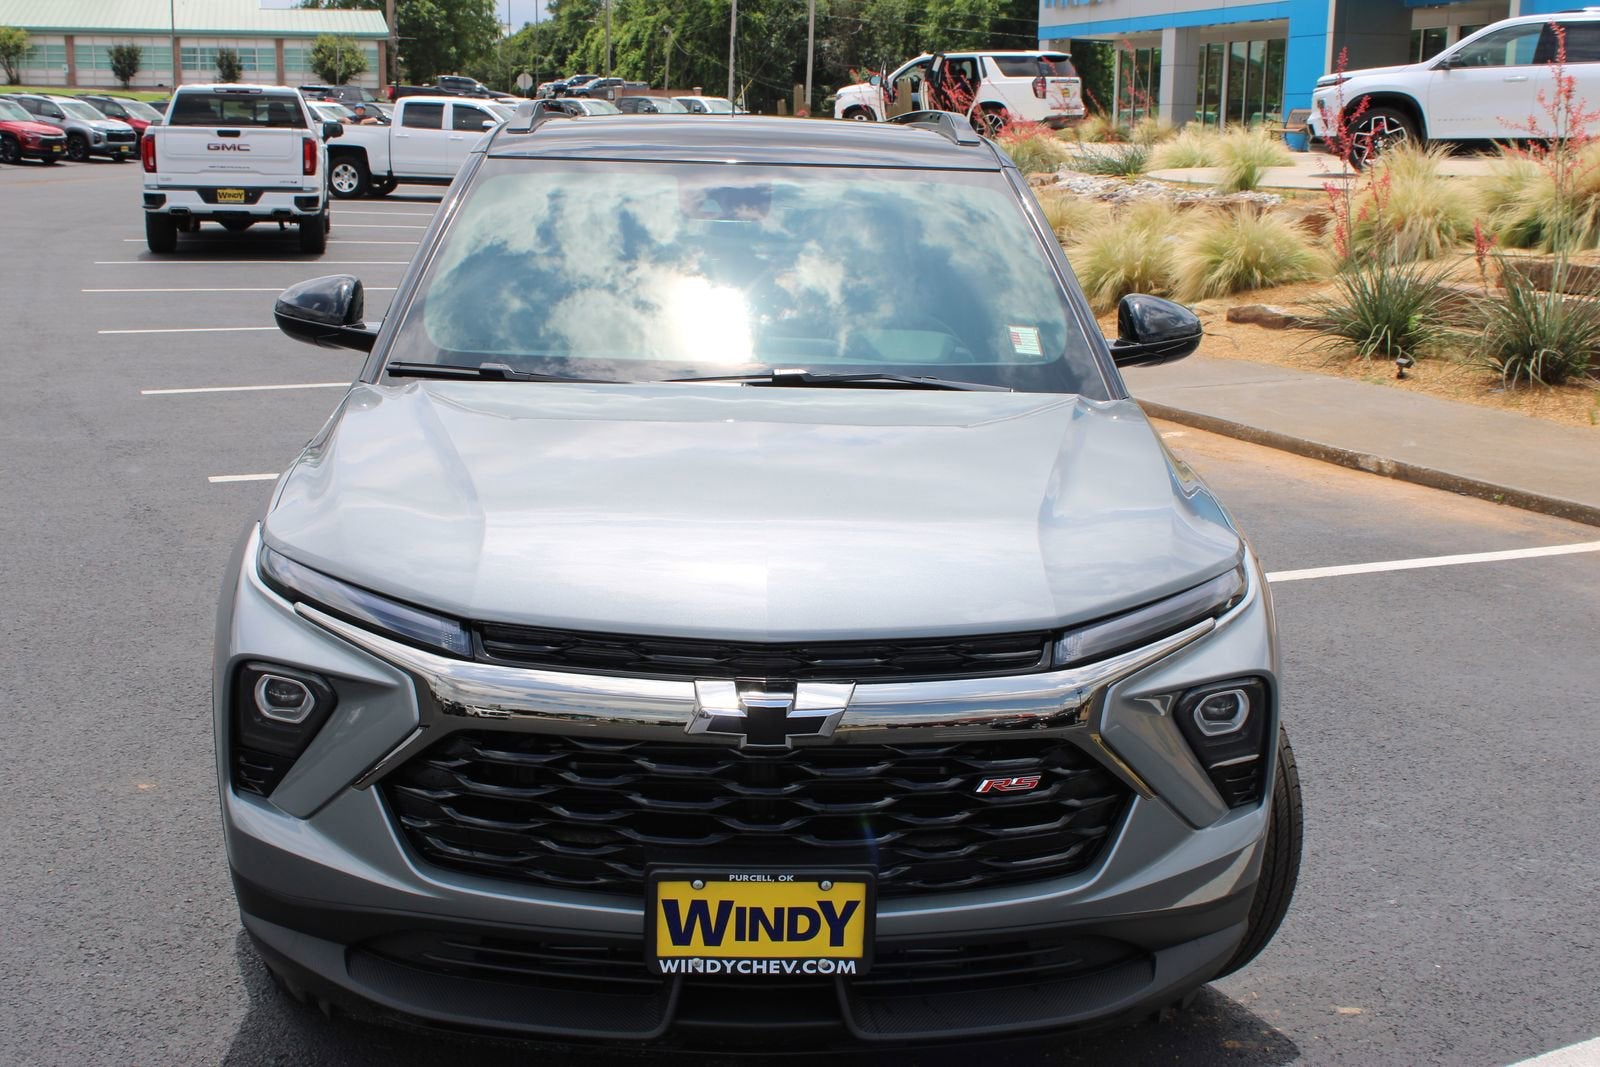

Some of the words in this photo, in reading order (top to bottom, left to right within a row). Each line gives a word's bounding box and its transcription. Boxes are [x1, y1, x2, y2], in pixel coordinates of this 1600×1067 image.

[207, 143, 250, 151] GMC
[975, 775, 1042, 793] RS
[729, 874, 775, 883] PURCELL,
[778, 874, 794, 882] OK
[661, 898, 861, 947] WINDY
[658, 959, 857, 975] WINDYCHEV.COM
